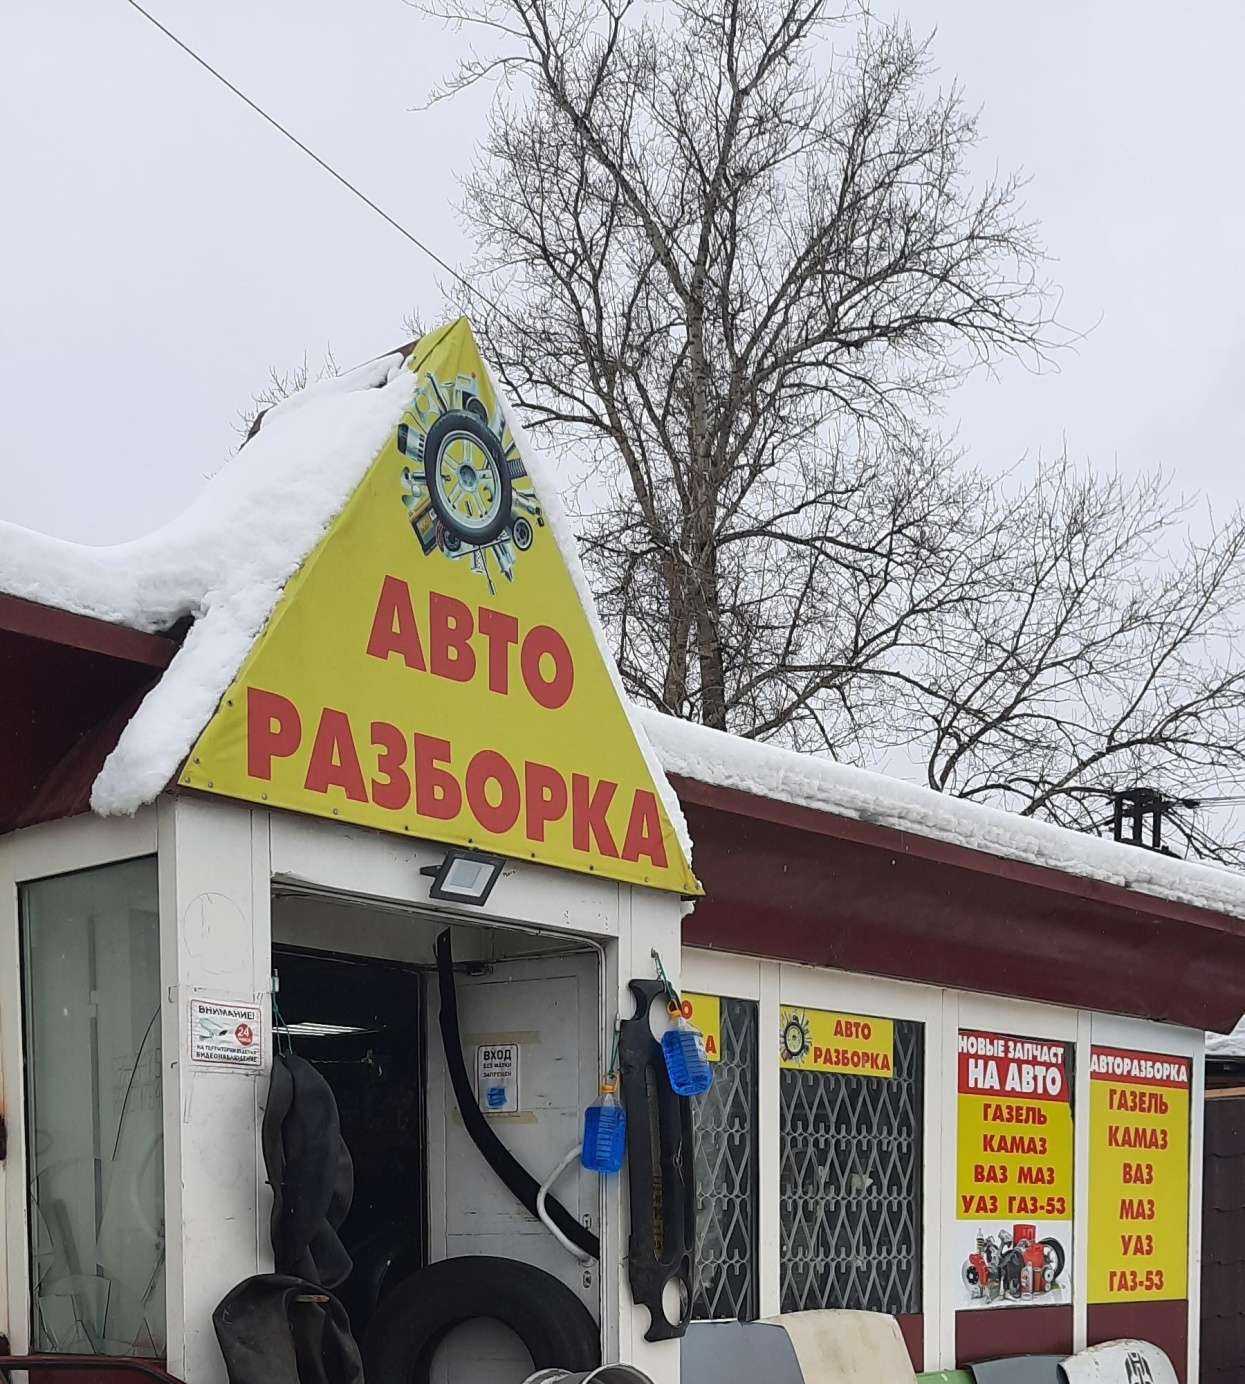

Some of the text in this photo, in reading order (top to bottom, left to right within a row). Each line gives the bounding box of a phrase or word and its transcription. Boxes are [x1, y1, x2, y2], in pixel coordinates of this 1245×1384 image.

[366, 574, 575, 710] АВТО
[246, 686, 669, 869] РАЗБОРКА
[198, 1005, 255, 1020] ВНИМАНИЕ!
[237, 1026, 250, 1037] 24
[833, 1019, 872, 1040] АВТО
[483, 1049, 512, 1061] ВХОД
[813, 1046, 891, 1072] РАЗБОРКА
[958, 1035, 1064, 1064] НОВЫЕ ЗАПЧАСТ
[968, 1058, 1062, 1096] НА АВТО
[1089, 1054, 1188, 1082] АВТОРАЗБОРКА
[1108, 1088, 1169, 1115] ГАЗЕЛЬ
[983, 1103, 1048, 1125] ГАЗЕЛЬ
[983, 1134, 1047, 1155] КАМАЗ
[1108, 1125, 1168, 1150] КАМАЗ
[974, 1164, 1055, 1185] ВАЗ МАЗ
[1122, 1162, 1154, 1185] ВАЗ
[961, 1194, 1066, 1215] УАЗ ГАЗ-53
[1119, 1198, 1155, 1220] МАЗ
[1121, 1234, 1153, 1256] УАЗ
[1108, 1270, 1164, 1292] ГАЗ-53
